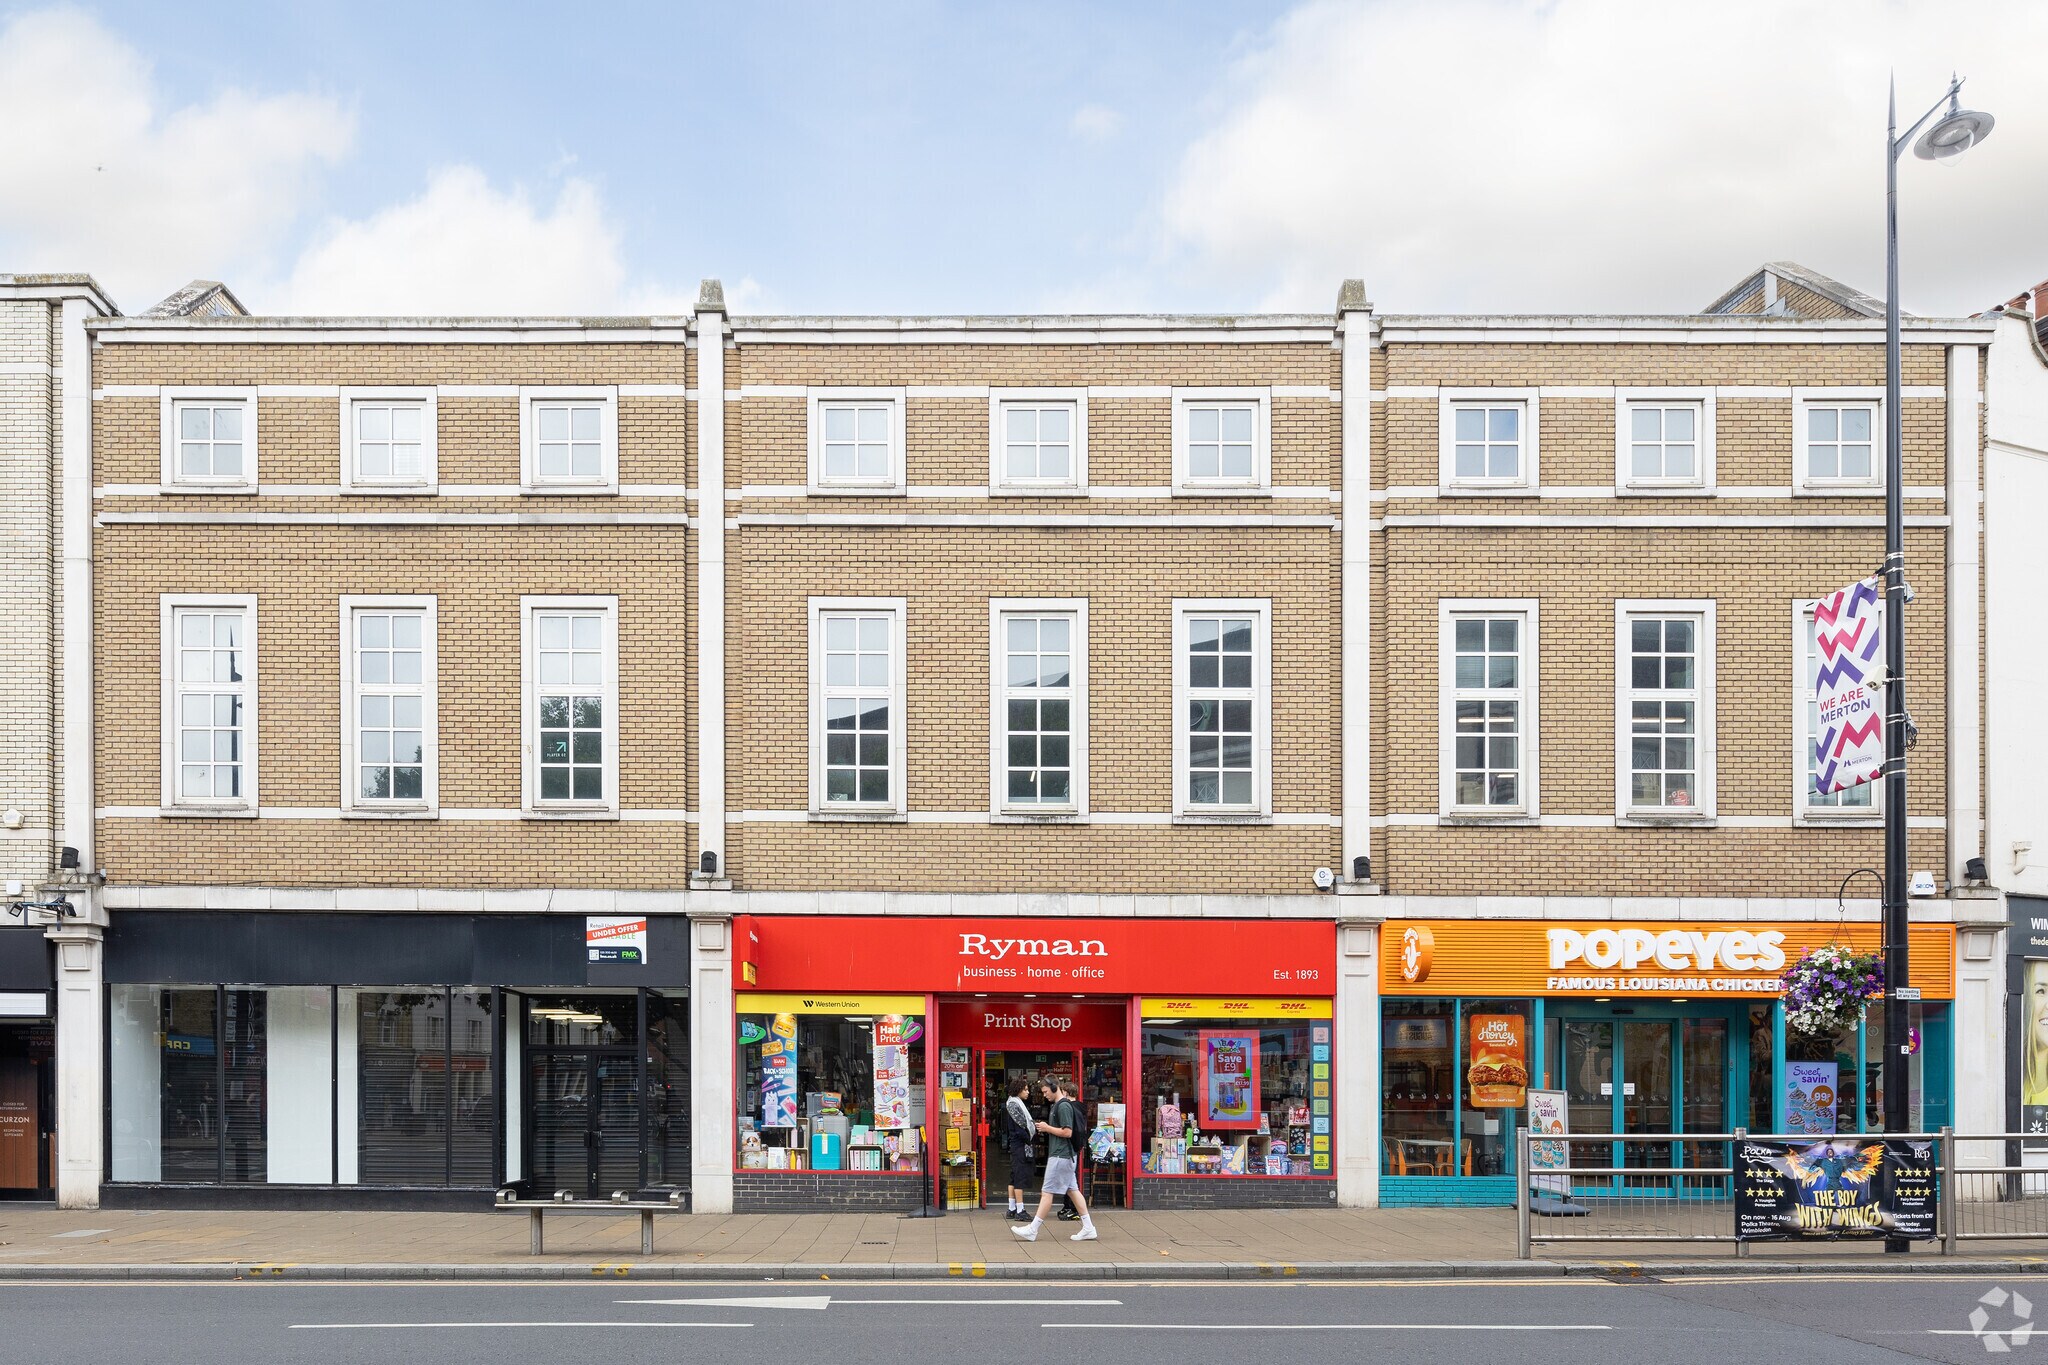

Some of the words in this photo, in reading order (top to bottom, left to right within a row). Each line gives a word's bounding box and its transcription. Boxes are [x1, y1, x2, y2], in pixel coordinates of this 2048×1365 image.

[1820, 697, 1836, 712] WE
[1840, 687, 1864, 705] ARE
[1820, 698, 1871, 724] MERTON
[592, 928, 616, 938] UNDER
[617, 924, 639, 933] OFFER
[958, 933, 1108, 960] Ryman
[963, 965, 1017, 977] business
[1027, 966, 1061, 978] home
[1071, 966, 1105, 978] office
[1273, 970, 1292, 980] Est.
[1295, 970, 1319, 980] 1893
[1547, 977, 1616, 990] FAMOUS
[1618, 977, 1710, 991] LOUISIANA
[984, 1013, 1026, 1028] Print
[1030, 1014, 1072, 1032] Shop
[1488, 1021, 1508, 1032] Hot
[880, 1025, 901, 1035] Half
[880, 1035, 901, 1043] Price
[1478, 1027, 1517, 1046] Honey
[1217, 1054, 1242, 1063] Save
[1224, 1063, 1236, 1071] £9
[1793, 1066, 1821, 1076] Sweet
[1802, 1075, 1830, 1083] savin'
[1535, 1096, 1553, 1110] Sweet
[1540, 1107, 1558, 1117] savin'
[1744, 1146, 1772, 1156] POLKA
[1914, 1148, 1930, 1160] Rep
[1813, 1190, 1836, 1207] THE
[1837, 1190, 1858, 1207] BOY
[1794, 1202, 1833, 1228] WITH
[1836, 1200, 1883, 1228] WINGS
